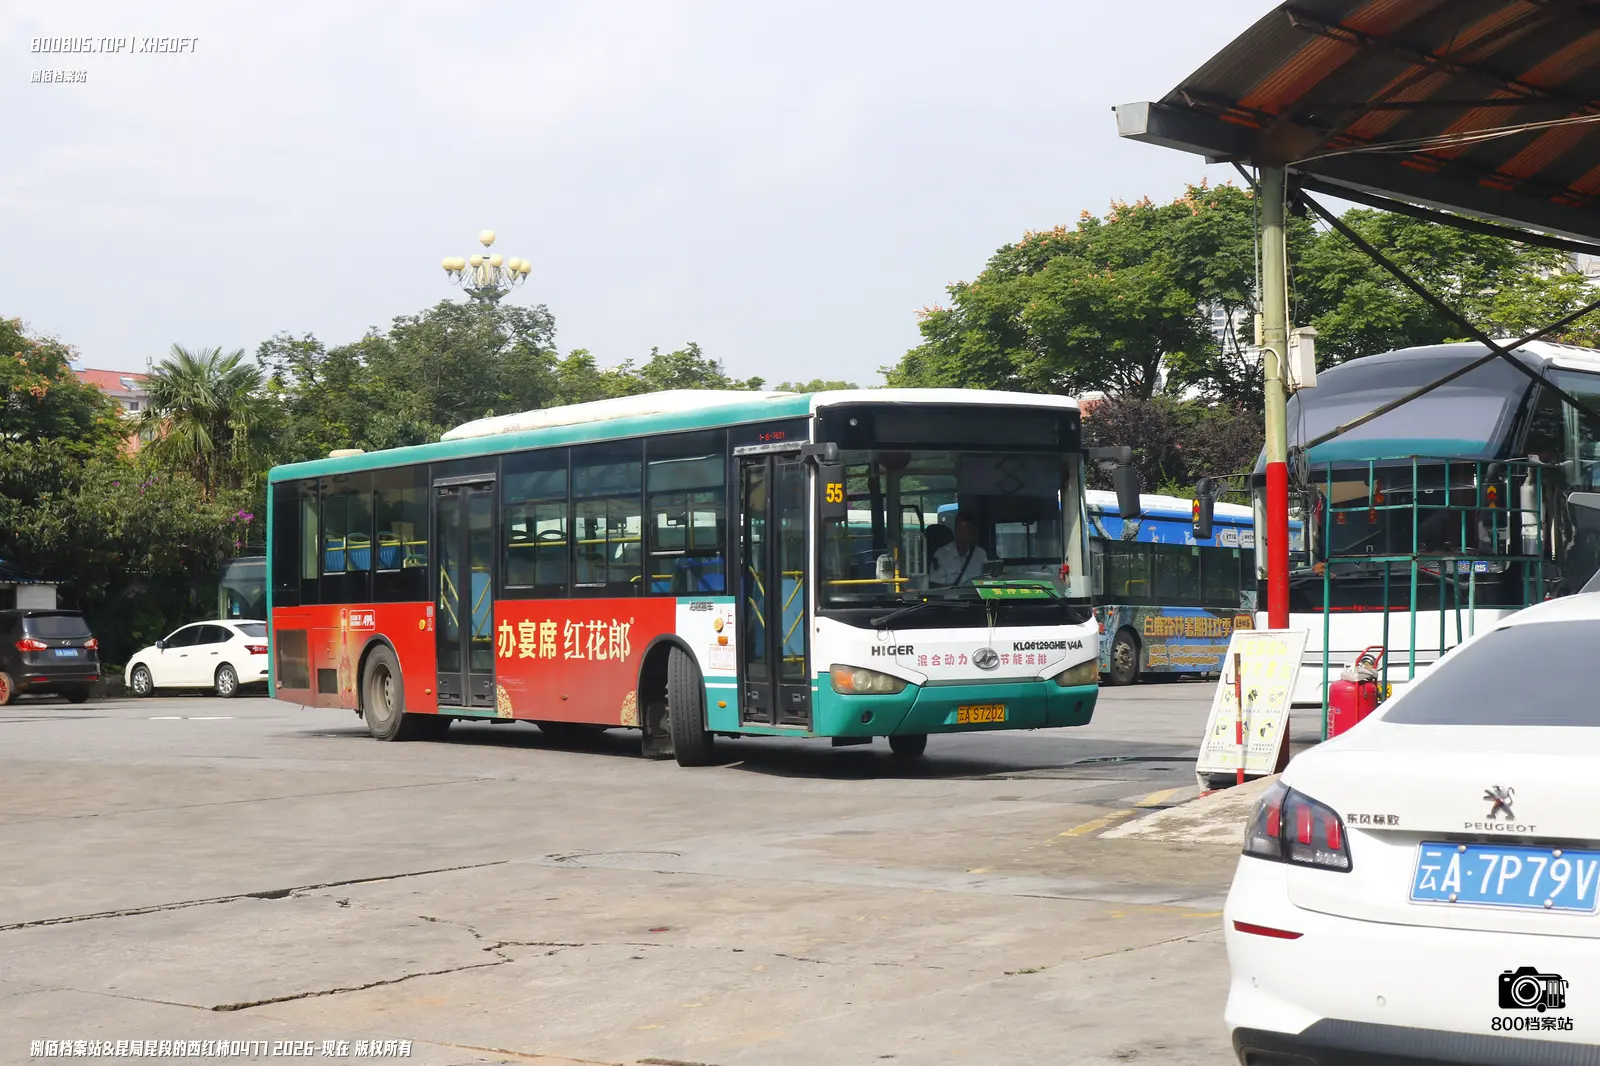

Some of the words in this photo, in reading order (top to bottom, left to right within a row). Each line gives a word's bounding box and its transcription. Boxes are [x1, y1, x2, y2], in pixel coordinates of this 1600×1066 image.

[825, 482, 843, 503] 55
[498, 618, 558, 660] 办宴席
[563, 617, 631, 663] 红花郎
[1013, 640, 1066, 652] KLQ6129GHE
[871, 645, 914, 657] HIGER
[917, 653, 968, 667] 混合动力
[1000, 653, 1047, 666] 节能减排
[1346, 813, 1400, 826] 东风标致
[1464, 821, 1536, 833] PEUGEOT
